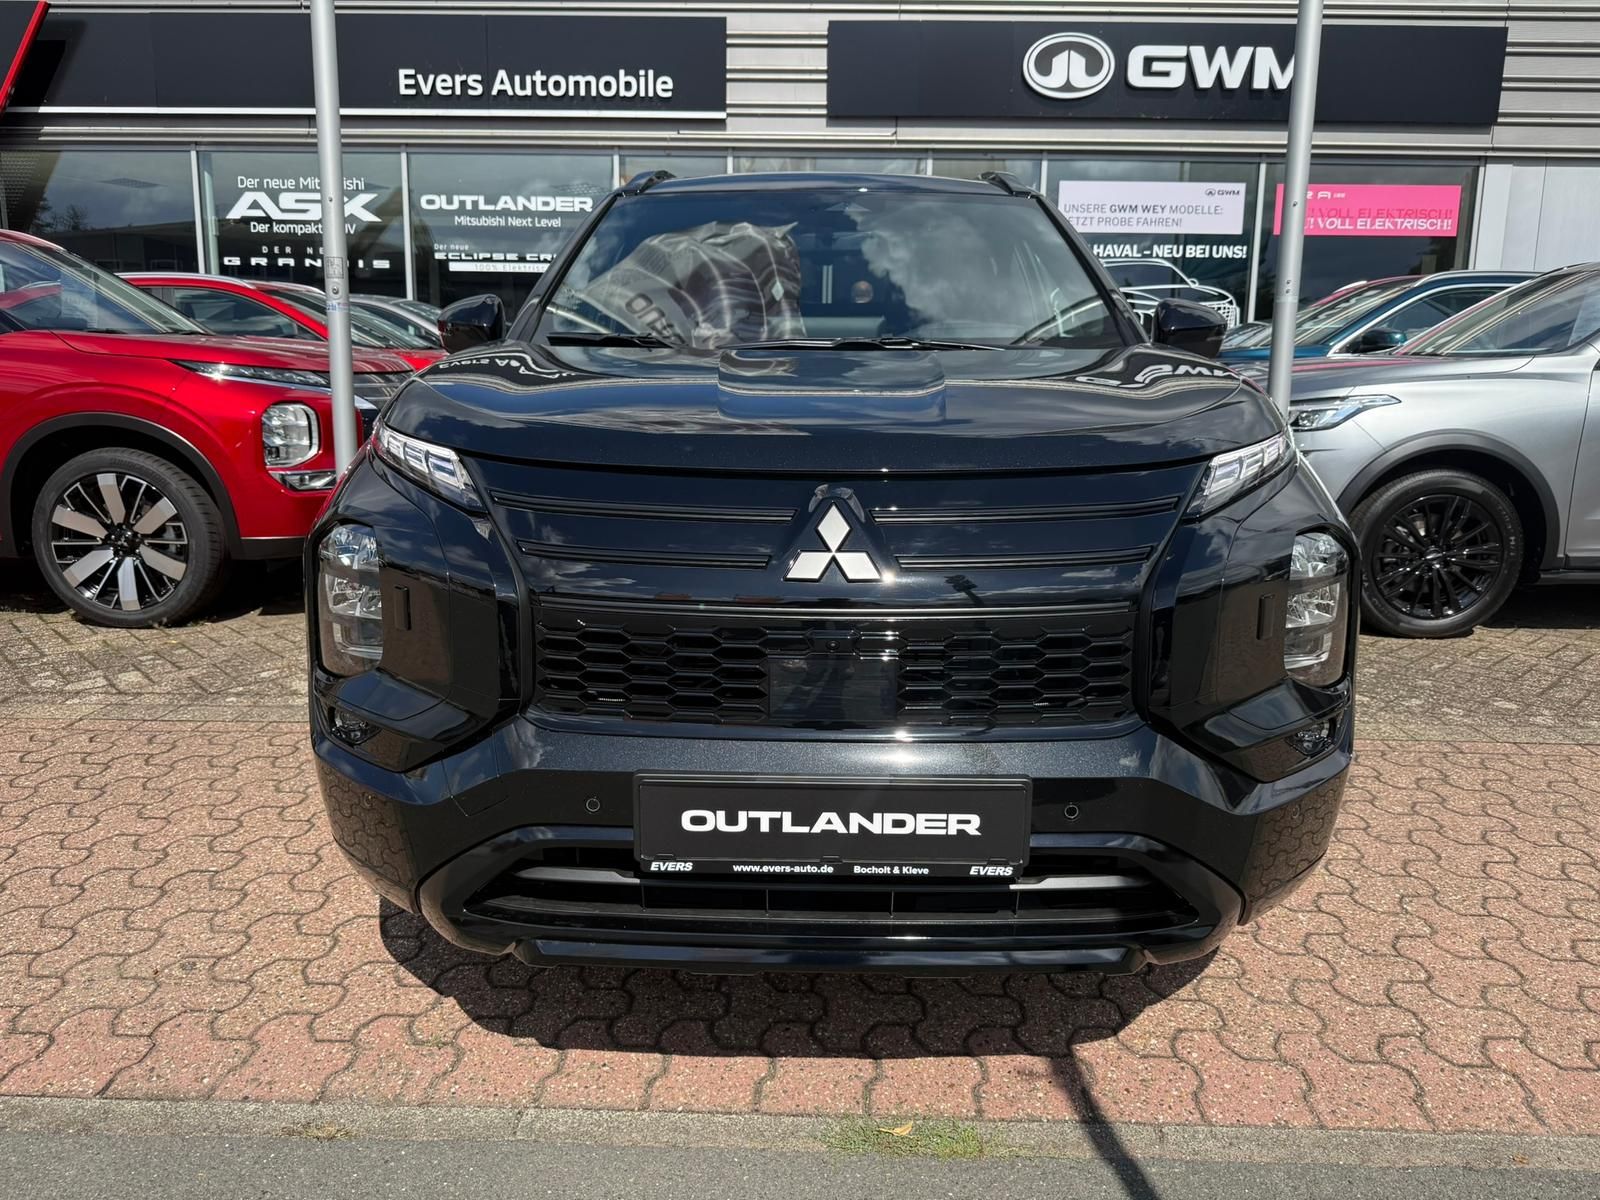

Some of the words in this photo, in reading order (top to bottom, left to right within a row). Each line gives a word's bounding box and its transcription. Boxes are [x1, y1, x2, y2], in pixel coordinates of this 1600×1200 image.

[1127, 45, 1295, 90] GWM
[398, 68, 484, 96] Evers
[491, 69, 674, 98] Automobile
[237, 175, 260, 189] Der
[263, 177, 296, 189] neue
[300, 176, 365, 190] Mitishi
[420, 194, 593, 213] OUTLANDER
[1064, 203, 1107, 214] UNSERE
[1109, 204, 1138, 214] GWM
[1141, 204, 1168, 214] WEY
[1169, 205, 1224, 215] MODELLE:
[250, 221, 271, 233] Der
[273, 222, 323, 236] kompakt
[454, 215, 506, 227] Mitsubishi
[508, 217, 533, 227] Next
[535, 217, 562, 228] Level
[1097, 216, 1134, 227] PROBE
[1136, 217, 1183, 227] FAHREN!
[1318, 218, 1355, 229] VOLL
[1356, 218, 1453, 230] ELEKTRISCH!
[262, 245, 292, 254] DER
[1093, 244, 1142, 257] HAVAL
[1153, 245, 1185, 258] NEU
[1185, 245, 1210, 258] BEI
[1212, 245, 1247, 258] UNS!
[223, 257, 391, 269] GRANIS
[434, 252, 519, 261] ECLIPSE
[526, 253, 558, 262] CR
[681, 809, 982, 836] OUTLANDER
[650, 861, 694, 871] EVERS
[732, 863, 834, 873] www.evers-auto.de
[853, 865, 891, 875] Bocholt
[892, 866, 900, 875] &
[902, 866, 930, 875] Kleve
[969, 866, 1014, 876] EVERS
